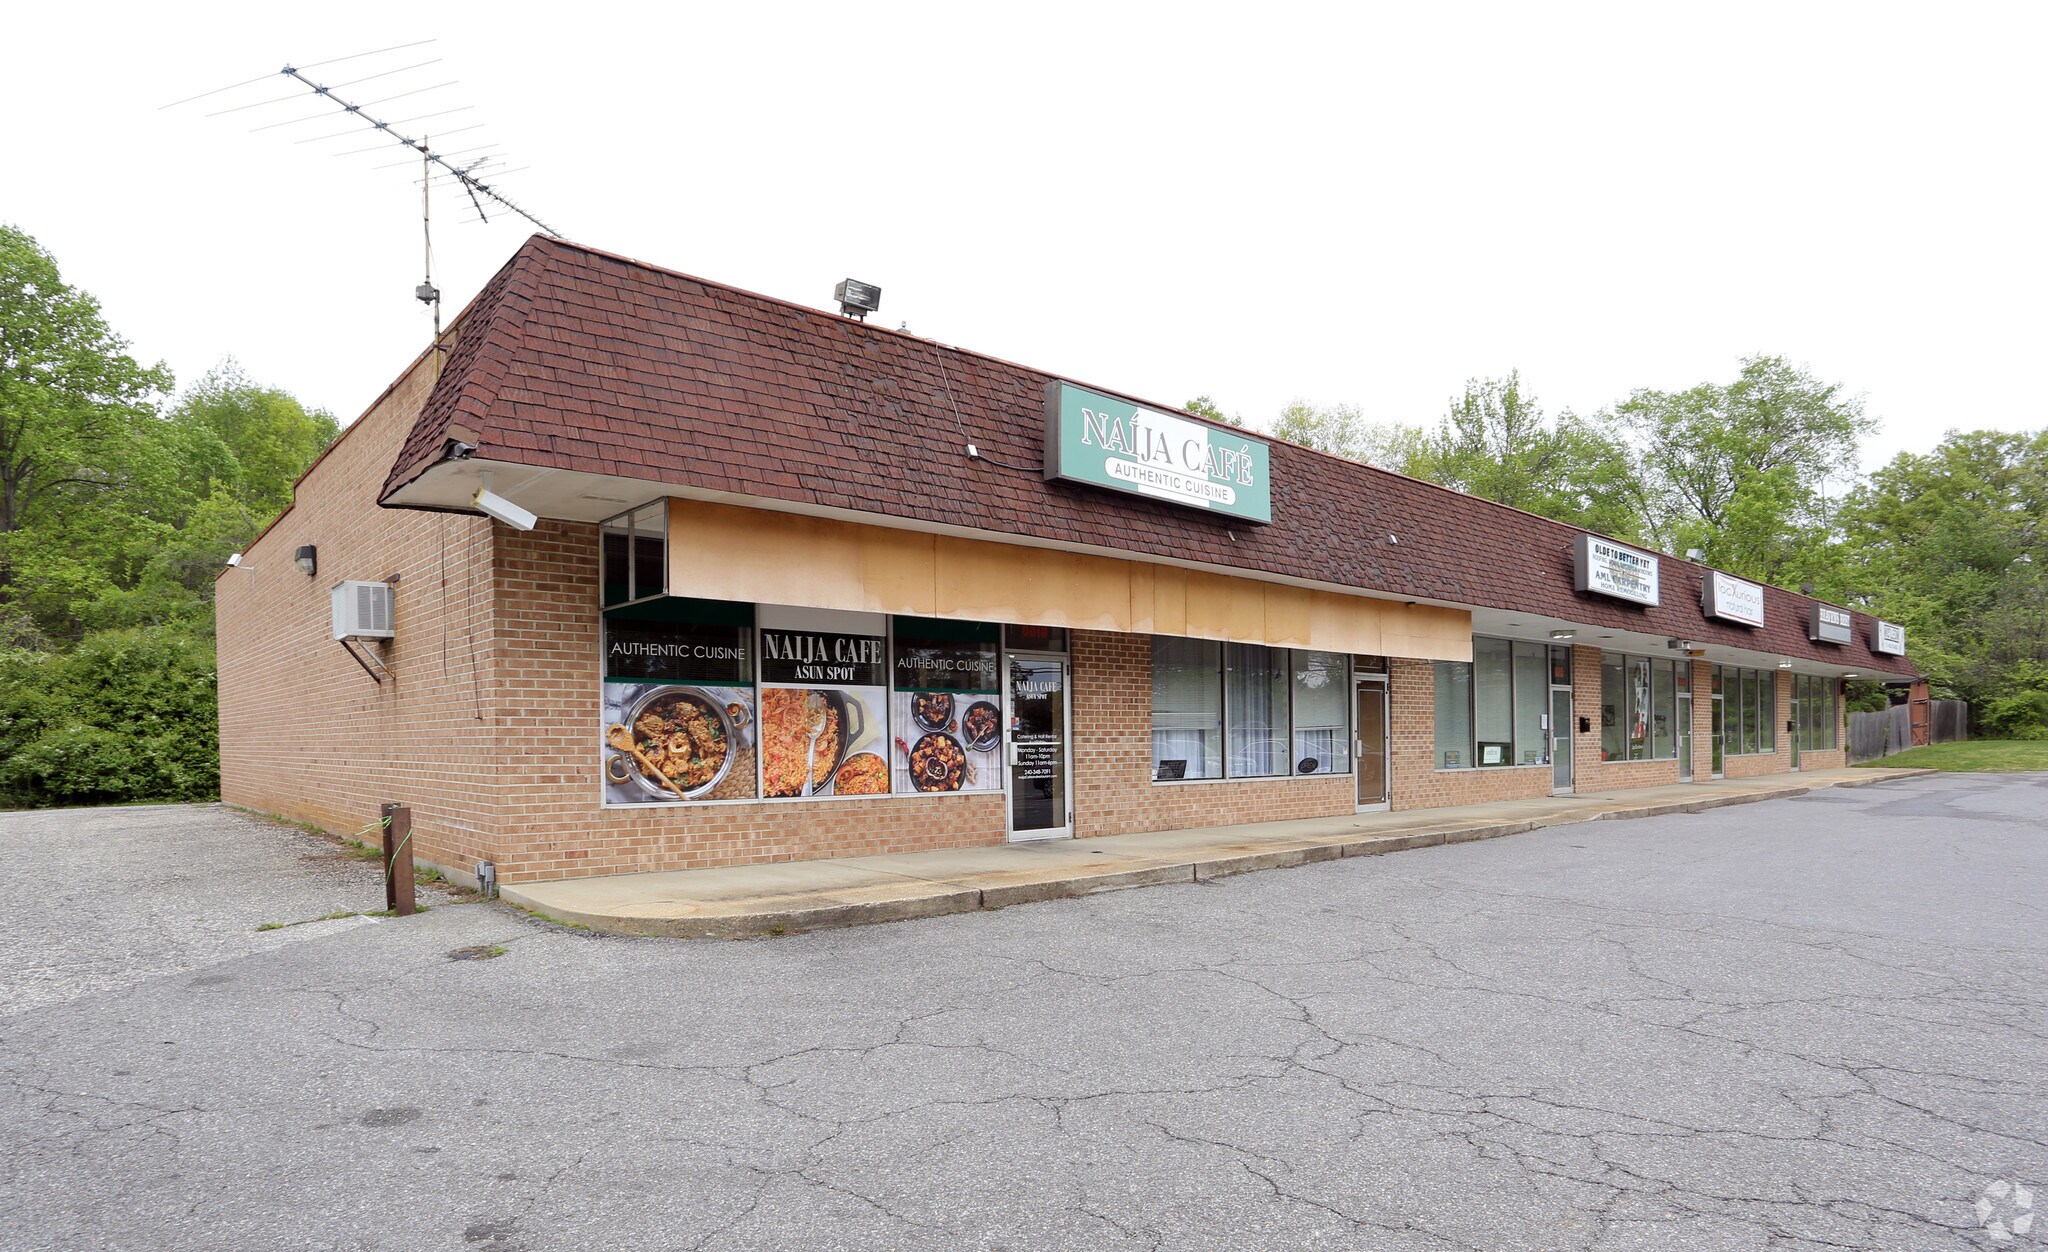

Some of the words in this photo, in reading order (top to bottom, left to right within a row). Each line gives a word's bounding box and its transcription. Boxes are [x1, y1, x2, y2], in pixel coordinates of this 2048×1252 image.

[1182, 438, 1254, 487] CAFÉ
[1115, 462, 1181, 489] AUTHENTIC
[1185, 479, 1229, 501] CUISINE
[1595, 544, 1610, 557] OLDE
[1611, 549, 1618, 559] TO
[1619, 552, 1639, 565] BETTER
[1640, 559, 1650, 569] YET
[1595, 570, 1611, 583] AML
[1612, 575, 1651, 593] CARPENTRY
[1616, 586, 1648, 600] REMODELING
[611, 642, 690, 658] AUTHENTIC
[693, 645, 746, 660] CUISINE
[764, 633, 829, 664] NAIJA
[834, 638, 882, 665] CAFE
[794, 665, 824, 680] ASUN
[826, 666, 856, 681] SPOT
[897, 657, 954, 671] AUTHENTIC
[956, 660, 994, 673] CUISINE
[1016, 680, 1039, 692] NAIJA
[1040, 681, 1057, 692] CAFE
